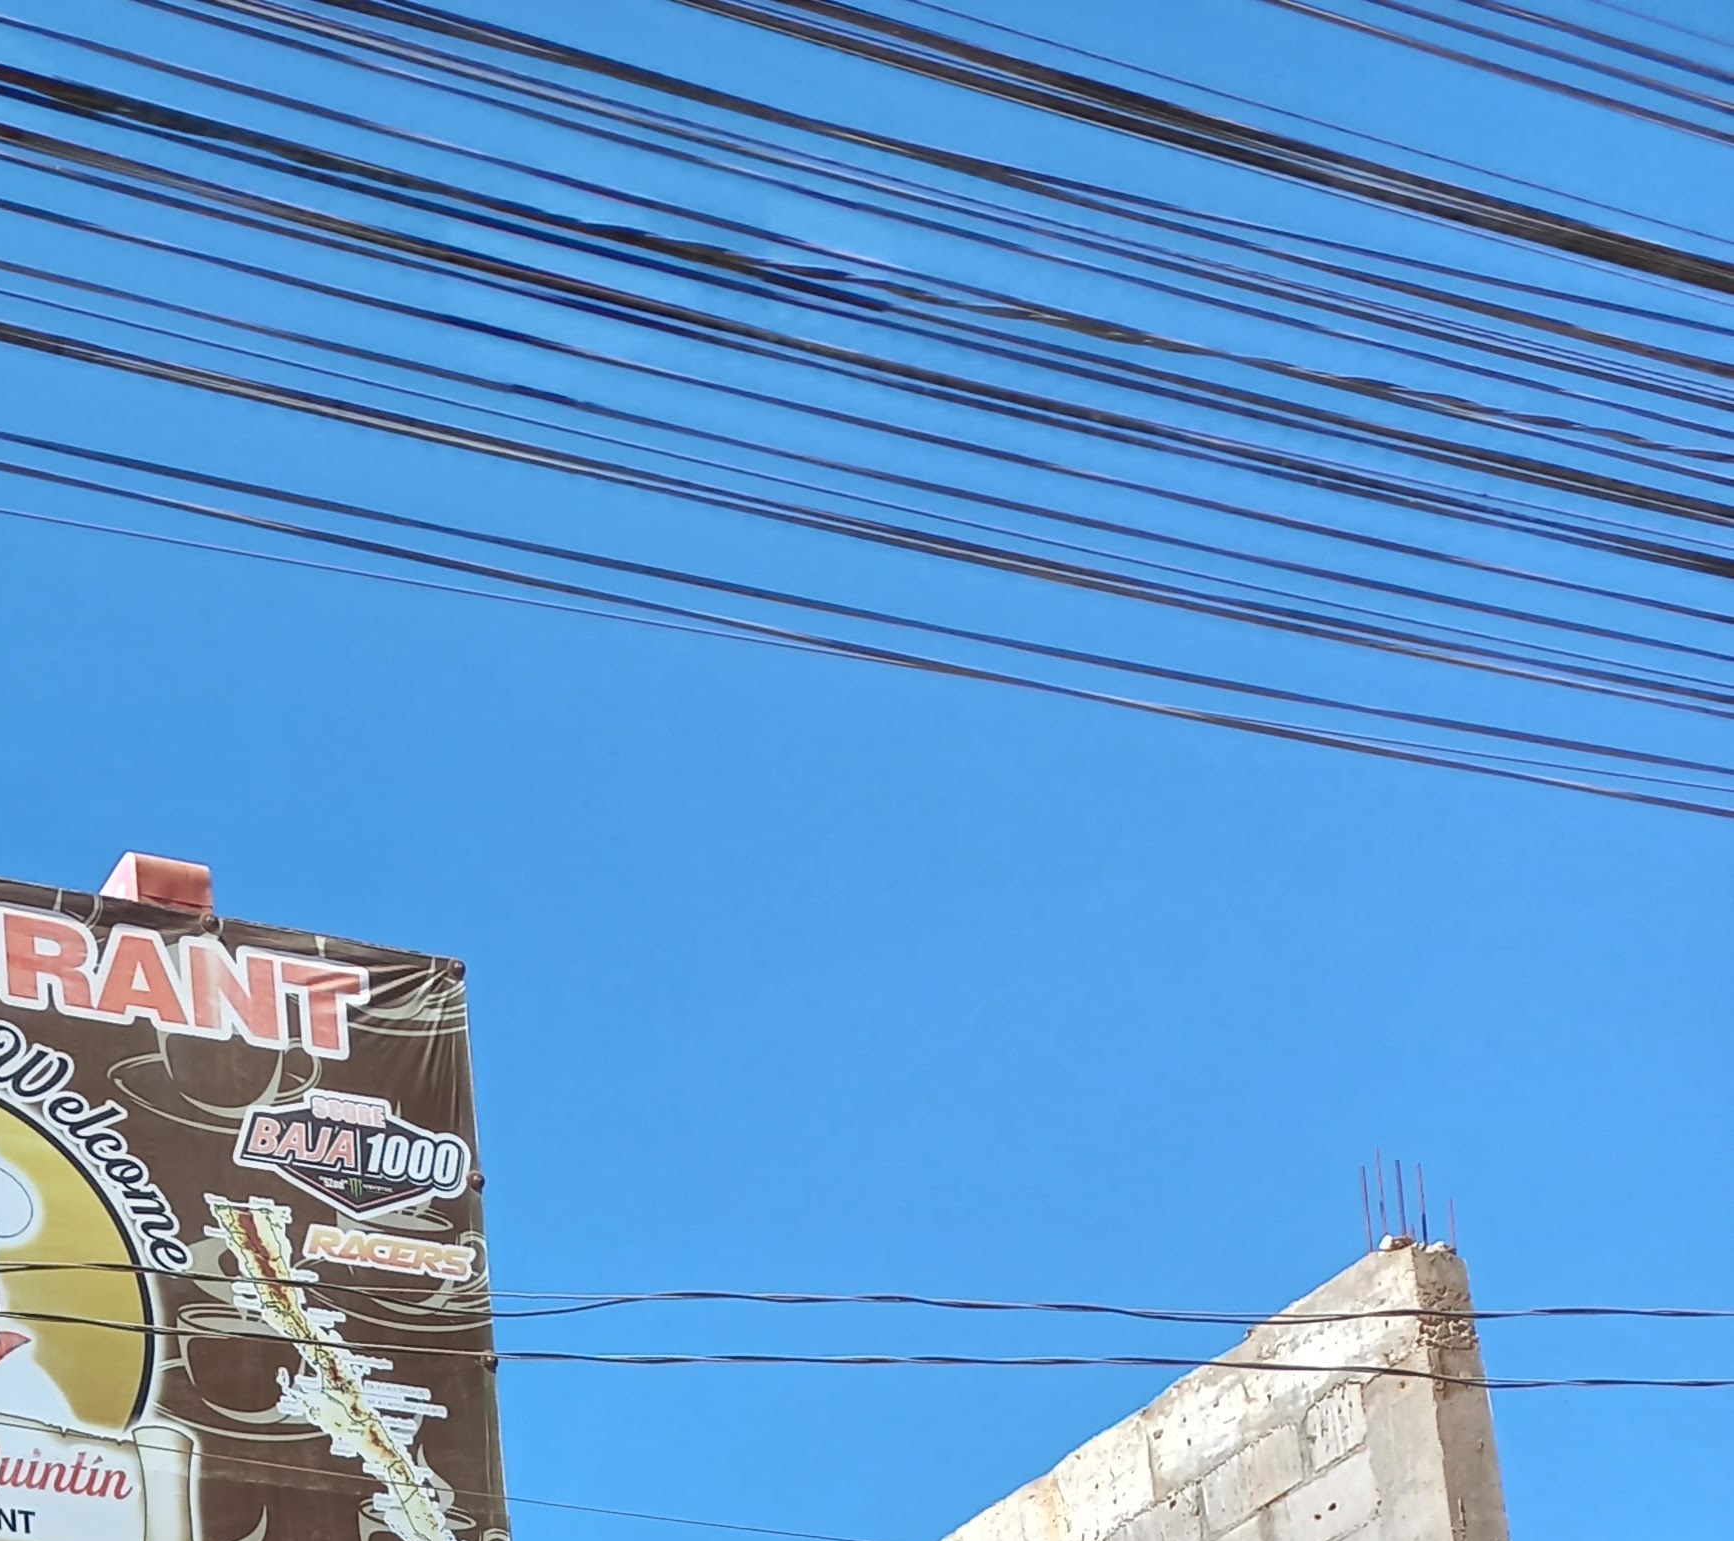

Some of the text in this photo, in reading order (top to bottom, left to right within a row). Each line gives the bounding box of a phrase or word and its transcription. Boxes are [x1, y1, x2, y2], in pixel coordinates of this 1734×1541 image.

[311, 1096, 387, 1129] SCORE
[247, 1116, 460, 1184] BAJA 1000
[308, 1229, 473, 1275] RACERS
